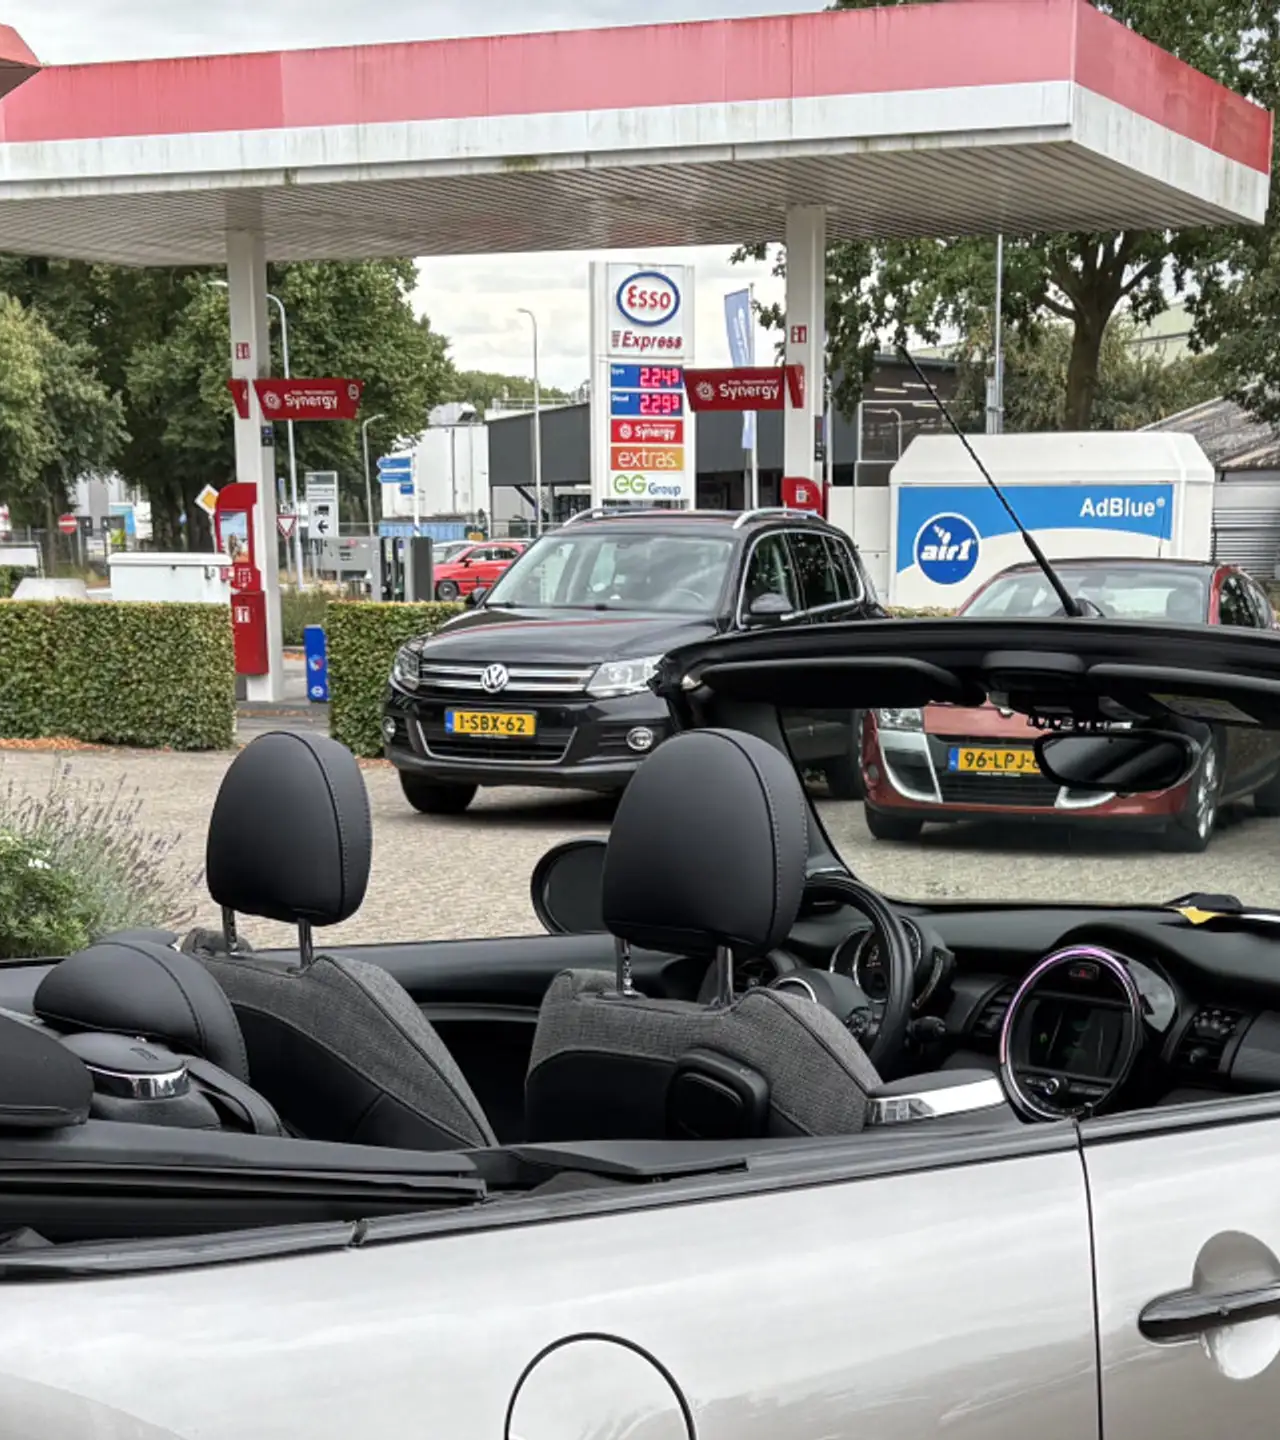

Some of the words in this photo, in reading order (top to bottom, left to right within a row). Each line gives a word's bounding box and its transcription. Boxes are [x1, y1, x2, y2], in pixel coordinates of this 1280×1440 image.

[626, 284, 672, 311] Esso
[621, 330, 683, 352] Express
[719, 382, 780, 400] Synergy
[283, 393, 339, 410] Synergy
[634, 425, 678, 441] Synergy
[648, 482, 682, 497] Group
[459, 714, 526, 733] 1-SBX-62
